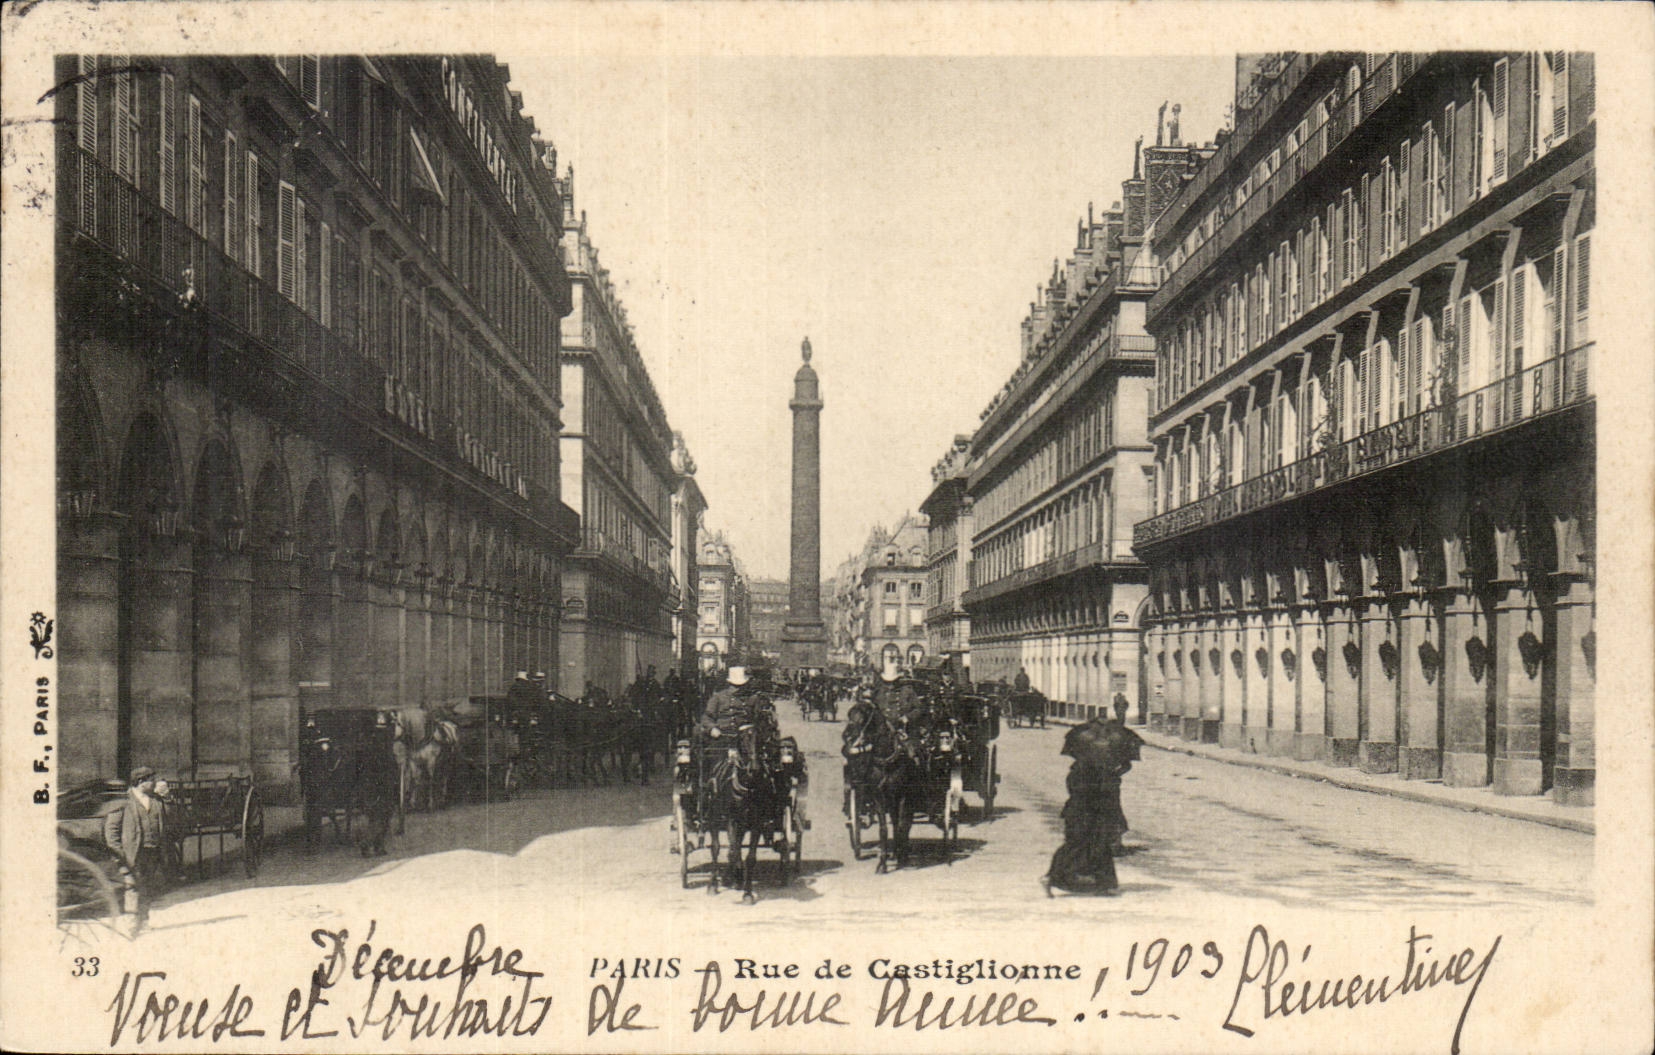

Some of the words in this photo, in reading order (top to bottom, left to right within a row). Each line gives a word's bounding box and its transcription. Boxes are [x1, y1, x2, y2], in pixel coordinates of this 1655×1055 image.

[1125, 937, 1224, 996] 1903
[280, 962, 339, 1042] et
[588, 974, 660, 1037] de
